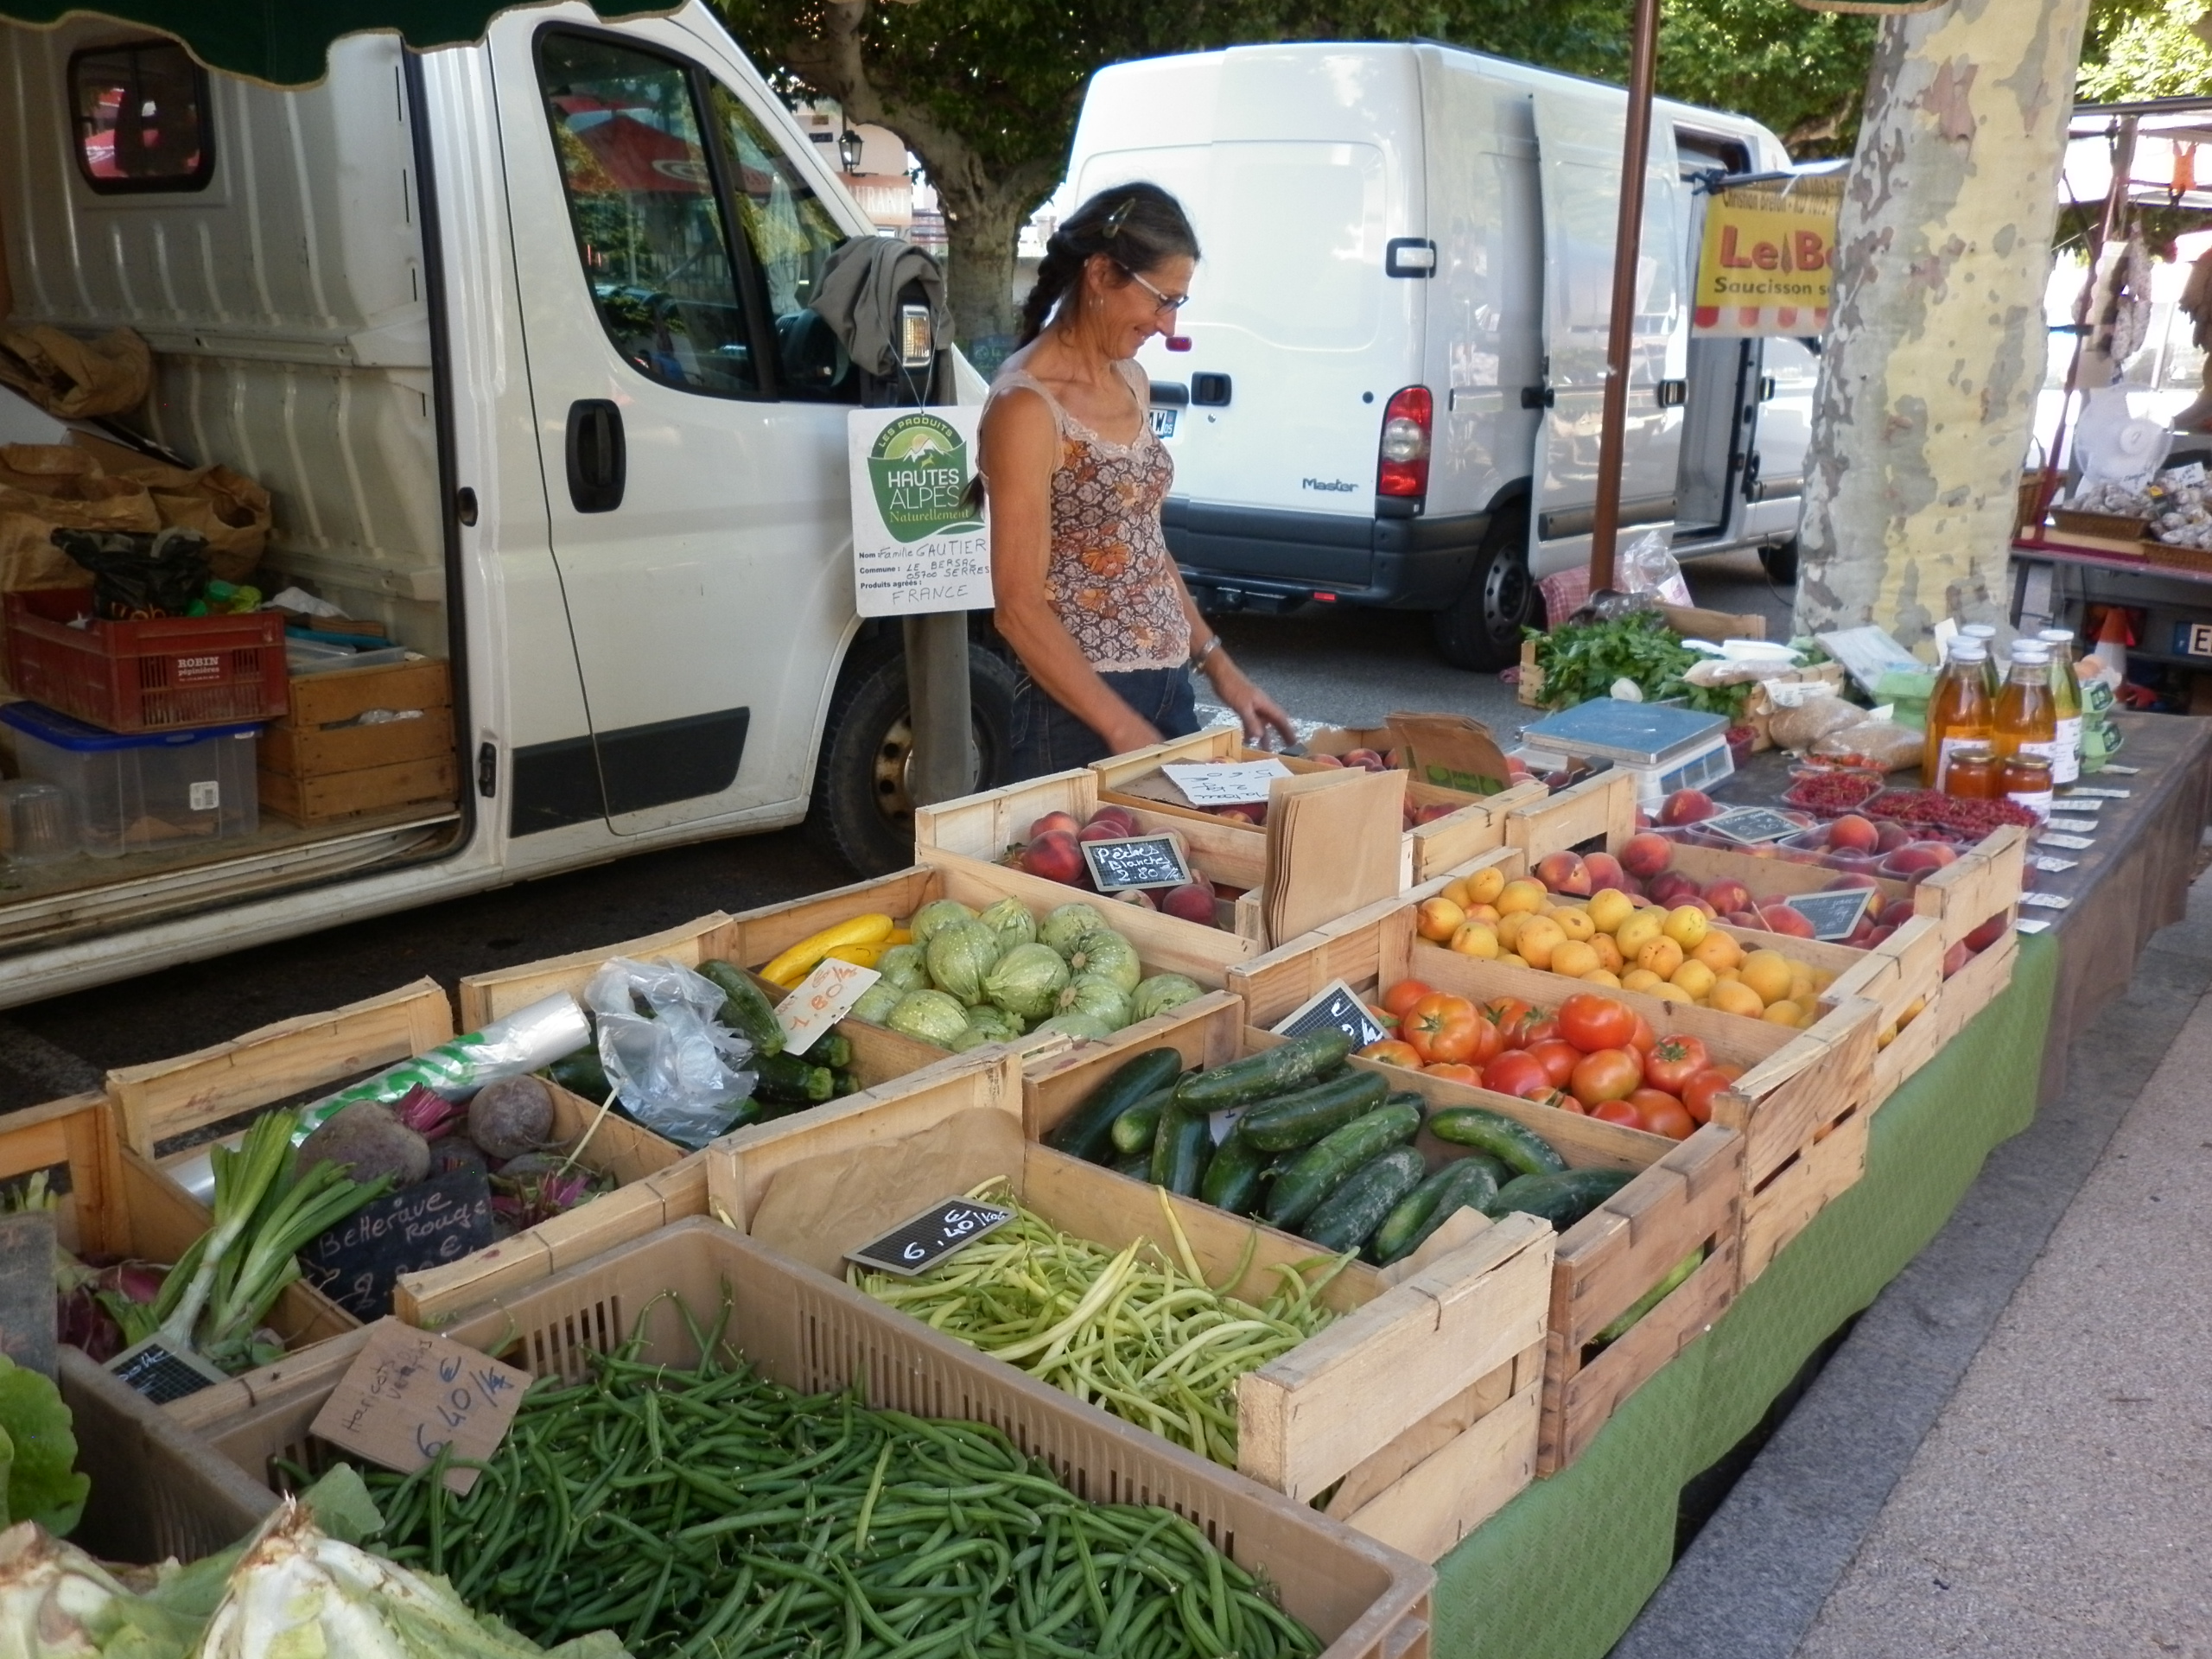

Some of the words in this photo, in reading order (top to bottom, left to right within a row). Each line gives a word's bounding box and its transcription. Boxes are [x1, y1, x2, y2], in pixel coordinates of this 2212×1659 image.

[849, 186, 907, 213] URANT
[1719, 225, 1779, 270] Le
[1713, 276, 1812, 294] Saucisson
[879, 427, 895, 448] LES
[898, 417, 953, 438] PRODUITS
[888, 468, 959, 488] HAUTES
[1303, 478, 1358, 493] Master
[890, 486, 959, 510] ALPES
[889, 508, 969, 523] Naturellement
[880, 546, 913, 559] Famille
[916, 538, 987, 557] GAUTIER
[906, 563, 920, 572] LE
[931, 559, 976, 570] BERSAC
[906, 570, 938, 580] 05700
[944, 566, 990, 577] SERRES
[861, 580, 891, 589] Produits
[893, 585, 969, 605] FRANCE
[2194, 627, 2212, 652] E
[178, 657, 219, 669] ROBIN
